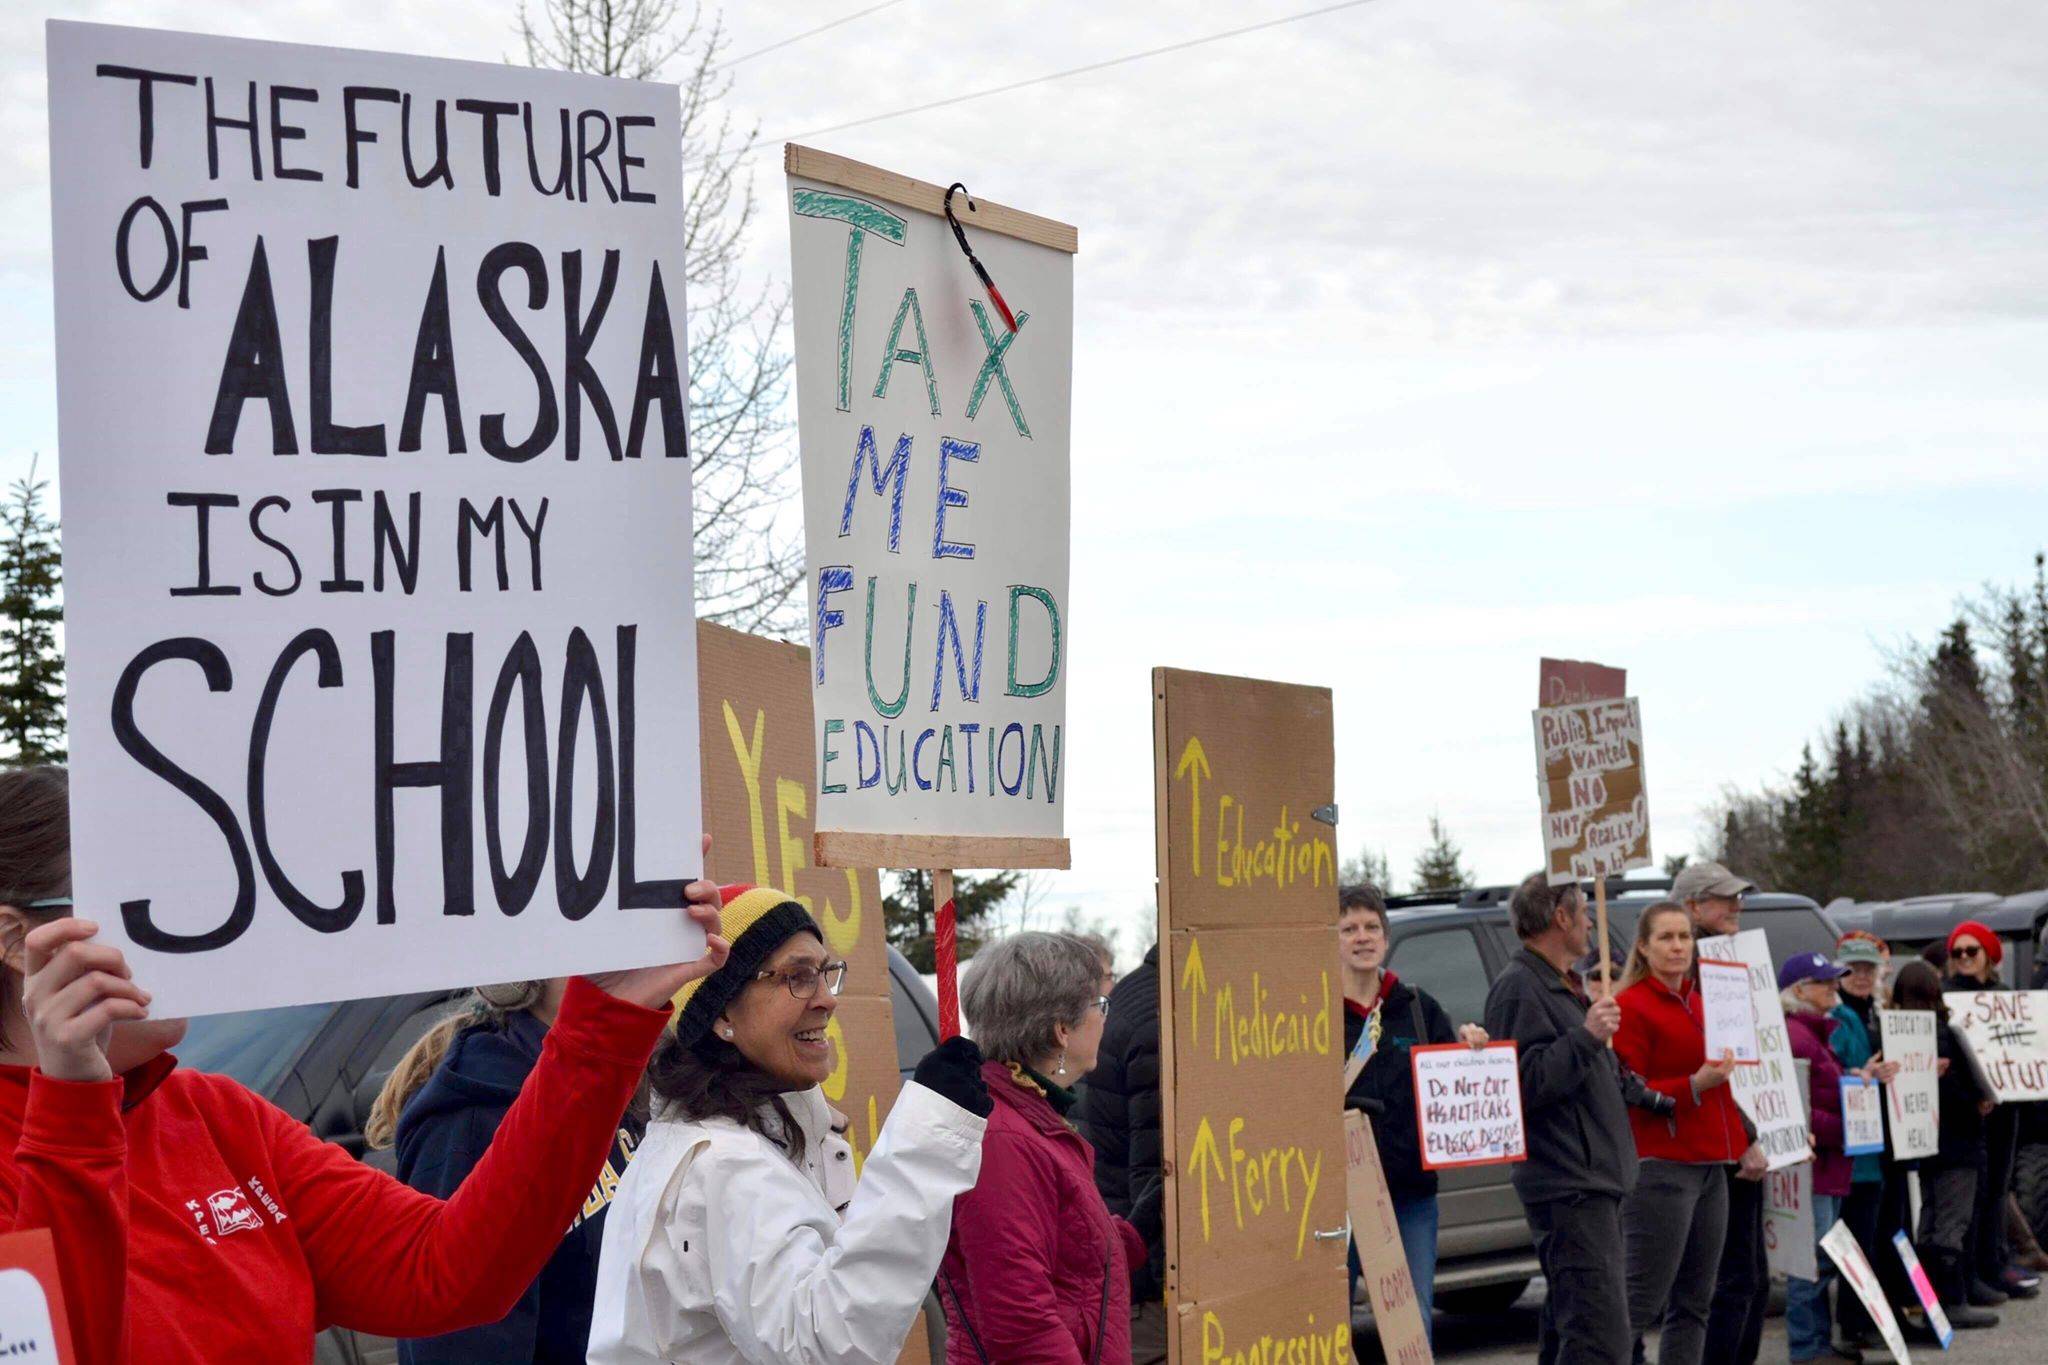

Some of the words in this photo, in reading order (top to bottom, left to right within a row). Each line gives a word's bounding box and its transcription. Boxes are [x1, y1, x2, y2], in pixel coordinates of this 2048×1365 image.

[97, 64, 323, 181] THE
[343, 86, 656, 204] FUTURE
[115, 195, 229, 309] OF
[205, 234, 688, 463] ALASKA
[793, 187, 1032, 440] TAX
[167, 491, 302, 596] IS
[312, 488, 421, 595] IN
[457, 496, 549, 592] MY
[838, 424, 981, 559] ME
[816, 565, 1062, 719] FUND
[822, 719, 1061, 803] EDUCATION
[1542, 714, 1588, 749] Public
[1593, 706, 1635, 738] Input
[111, 624, 699, 953] SCHOOL
[1552, 814, 1579, 839] NOT
[1574, 778, 1605, 807] NO
[1217, 795, 1334, 889] Education
[1214, 971, 1331, 1066] Medicaid
[1975, 991, 2033, 1022] SAVE
[1988, 1022, 2034, 1046] THE
[1985, 1049, 2047, 1091] utur
[1229, 1117, 1322, 1261] Ferry
